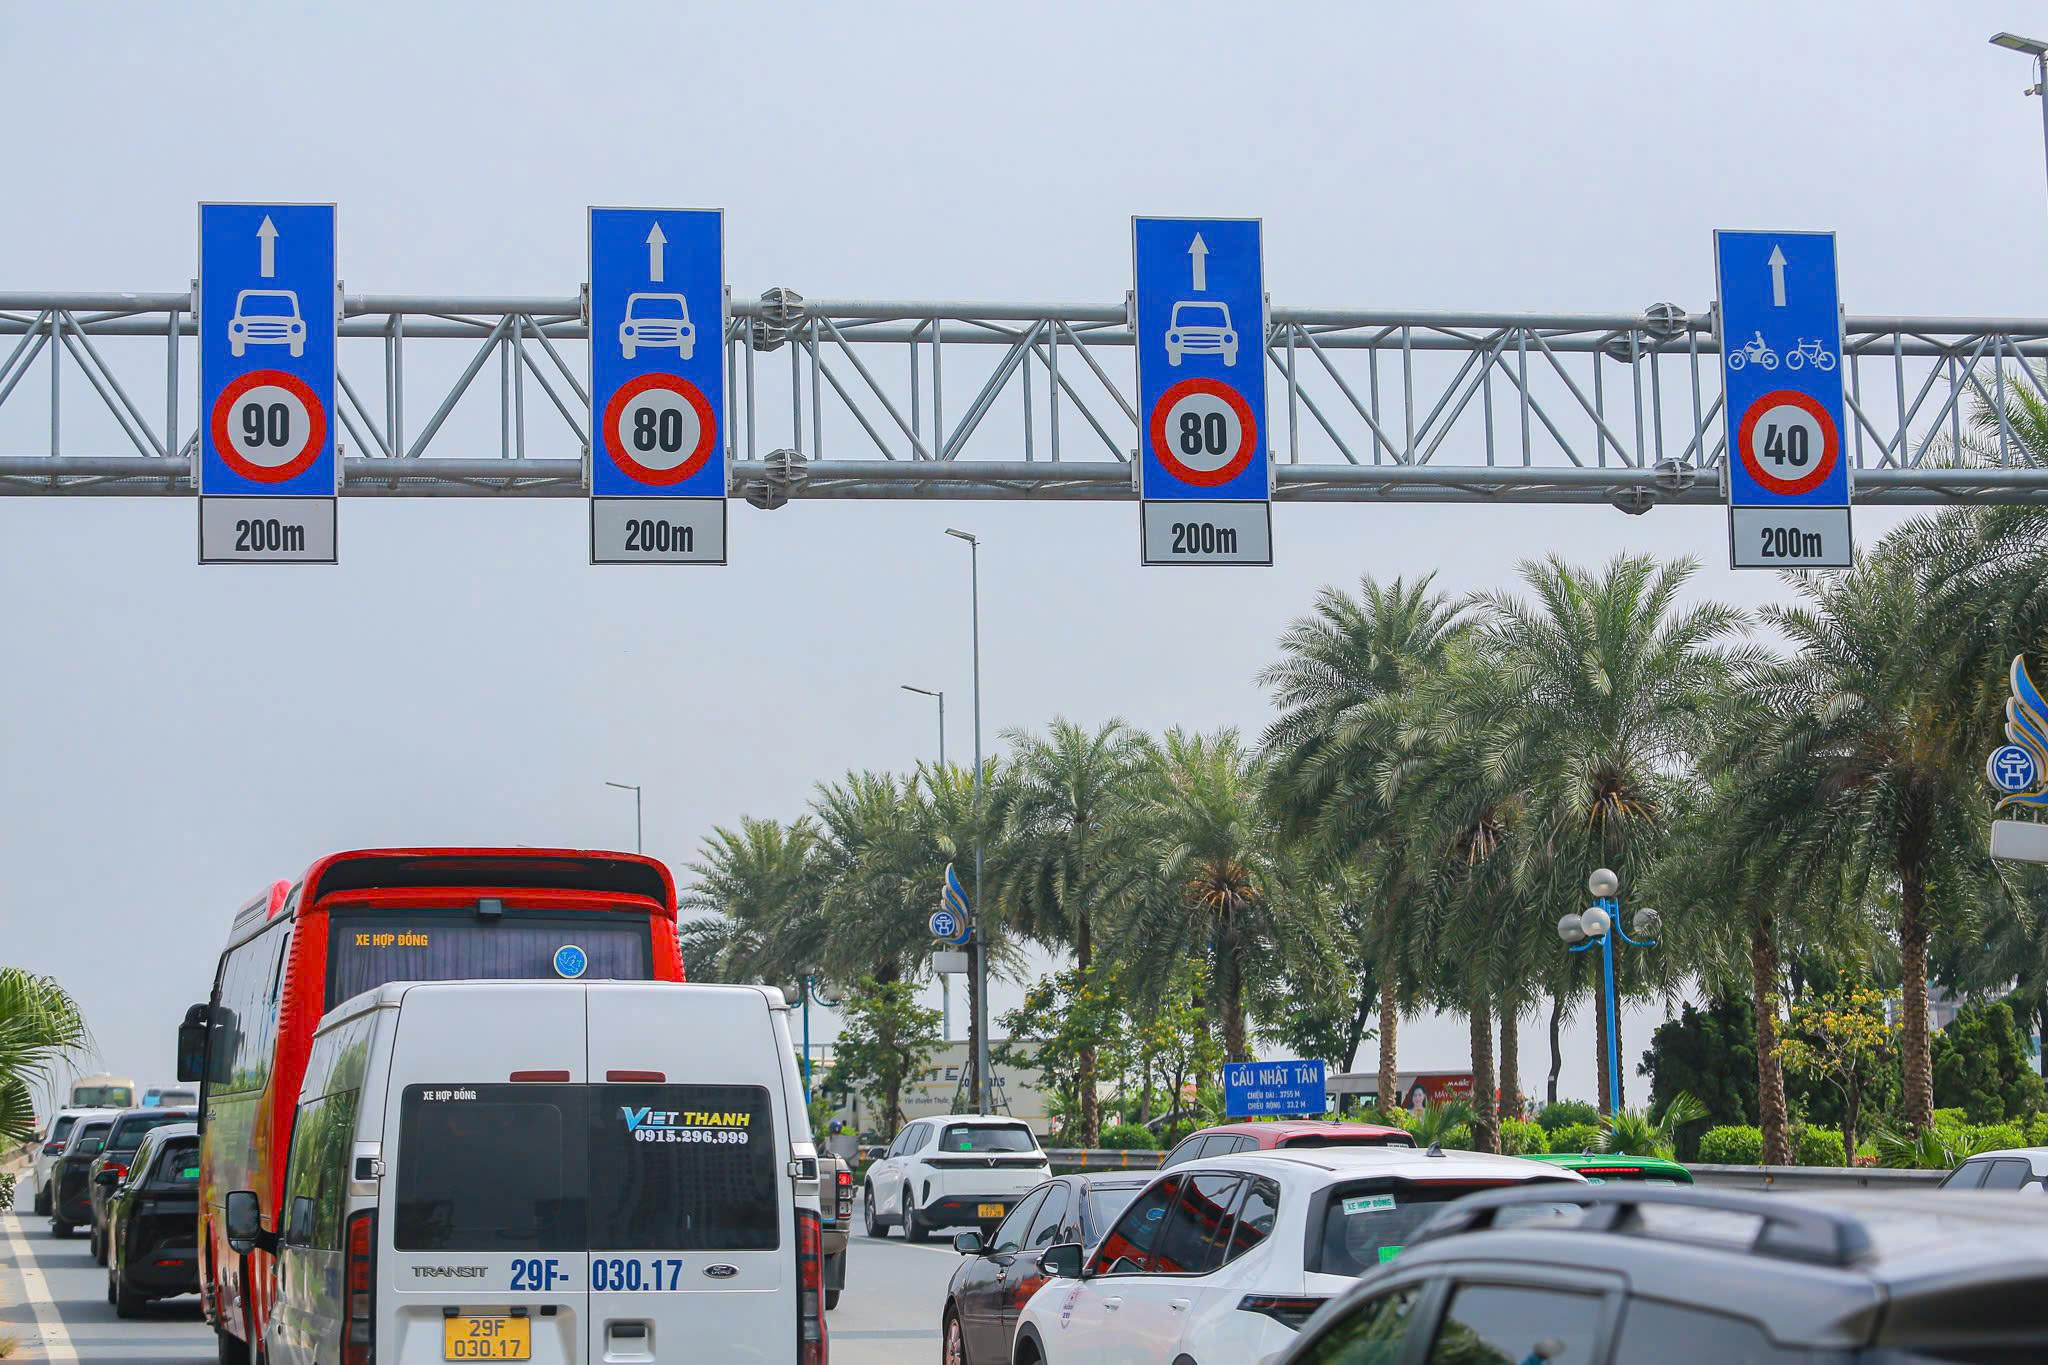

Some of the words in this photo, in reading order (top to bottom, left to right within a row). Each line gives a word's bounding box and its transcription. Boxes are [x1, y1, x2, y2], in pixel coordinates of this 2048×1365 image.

[242, 403, 289, 447] 90
[633, 407, 683, 452] 80
[1179, 412, 1227, 455] 80
[1763, 424, 1809, 467] 40
[235, 519, 305, 551] 200m
[625, 519, 694, 552] 200m
[1171, 522, 1238, 554] 200m
[1761, 527, 1823, 558] 200m
[355, 934, 370, 946] XE
[372, 933, 395, 949] HỢP
[397, 929, 429, 946] ĐỒNG
[1231, 1065, 1254, 1086] CẦU
[1259, 1065, 1288, 1088] NHẬT
[1295, 1064, 1318, 1084] TÂN
[423, 1091, 434, 1100] XE
[435, 1090, 452, 1102] HỢP
[453, 1086, 477, 1100] ĐỒNG
[1280, 1090, 1294, 1098] 3755
[1294, 1090, 1301, 1098] M
[684, 1112, 750, 1126] THANH
[635, 1130, 749, 1144] 0915.296.999
[412, 1266, 488, 1278] TRANSIT
[510, 1258, 569, 1290] 29F-
[592, 1259, 683, 1291] 030.17
[469, 1319, 505, 1337] 29F
[454, 1340, 521, 1357] 030.17
